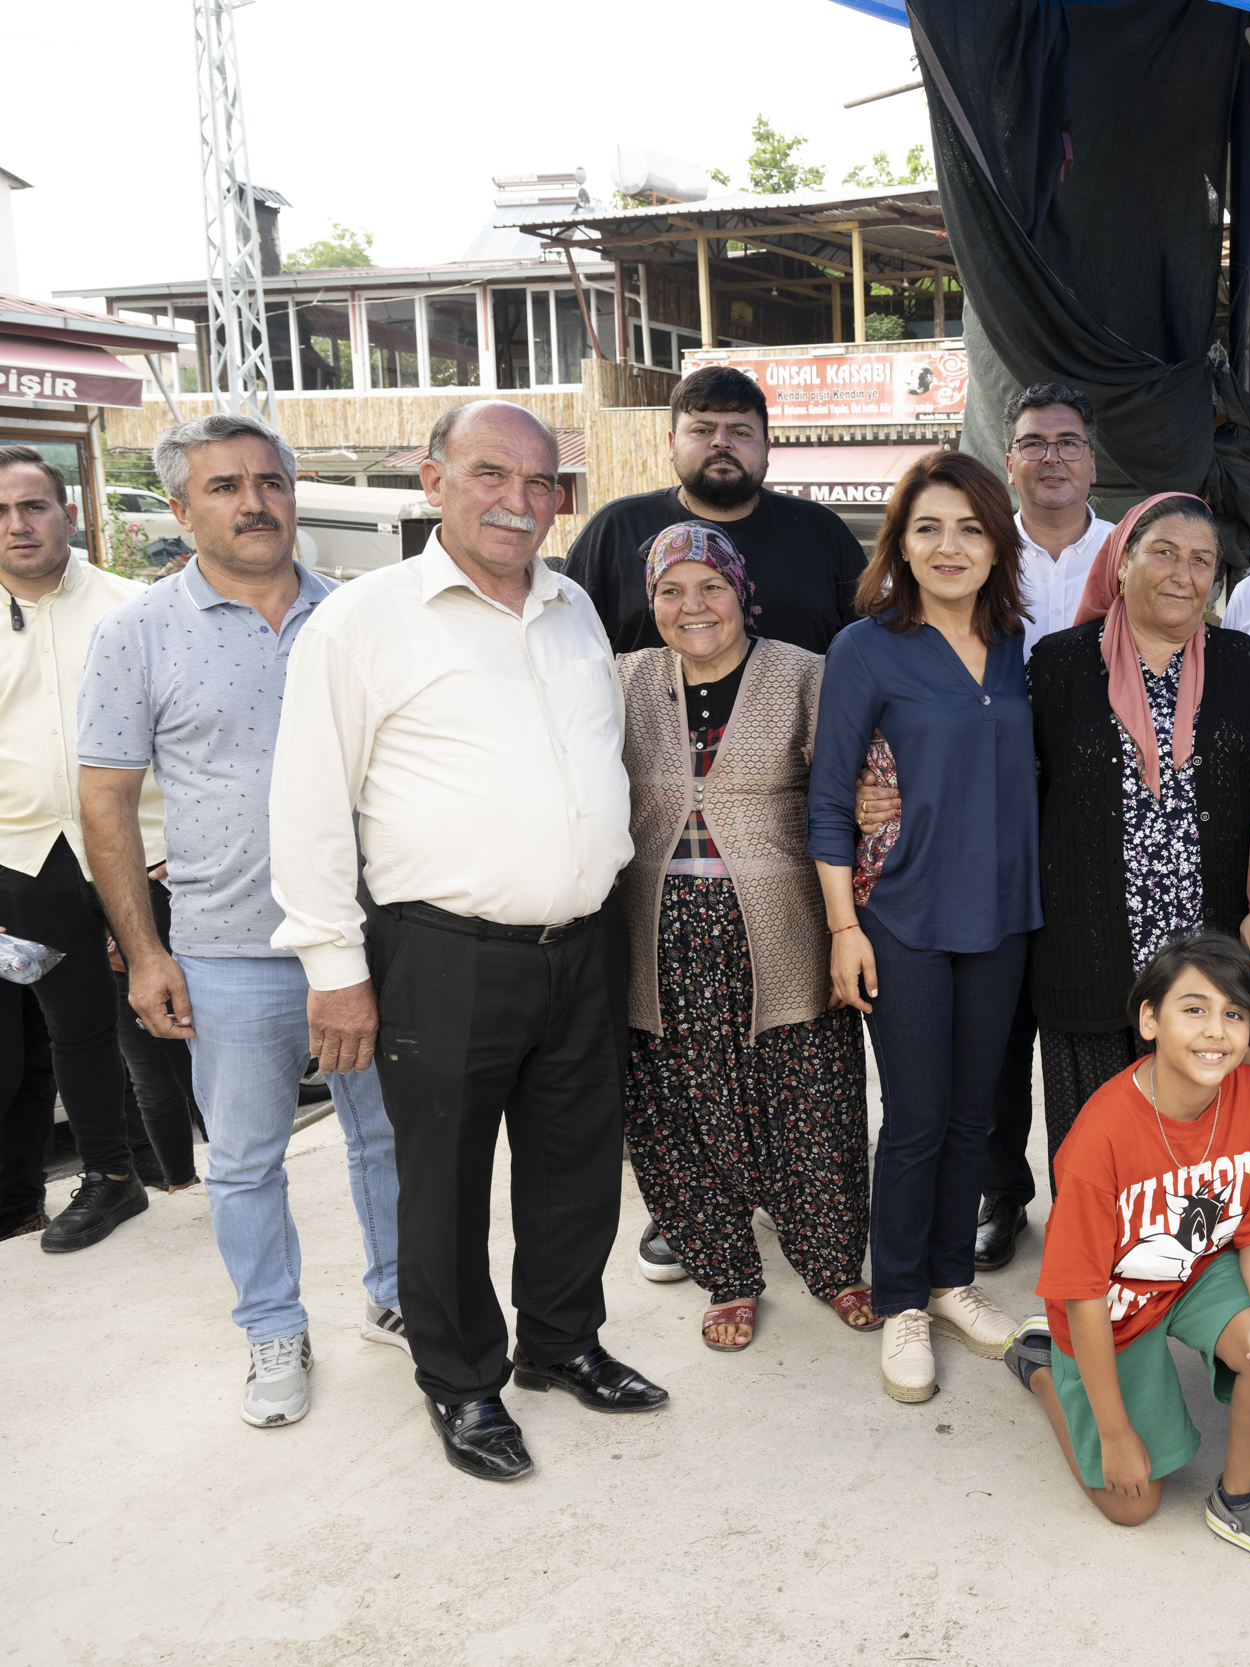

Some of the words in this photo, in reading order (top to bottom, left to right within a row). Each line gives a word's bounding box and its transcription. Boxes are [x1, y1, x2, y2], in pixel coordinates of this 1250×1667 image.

[766, 363, 821, 386] ÜNSAL
[826, 362, 892, 385] KASABI
[777, 389, 808, 401] Kendin
[810, 388, 830, 403] pişir
[833, 388, 865, 400] Kendin
[867, 390, 878, 401] ye
